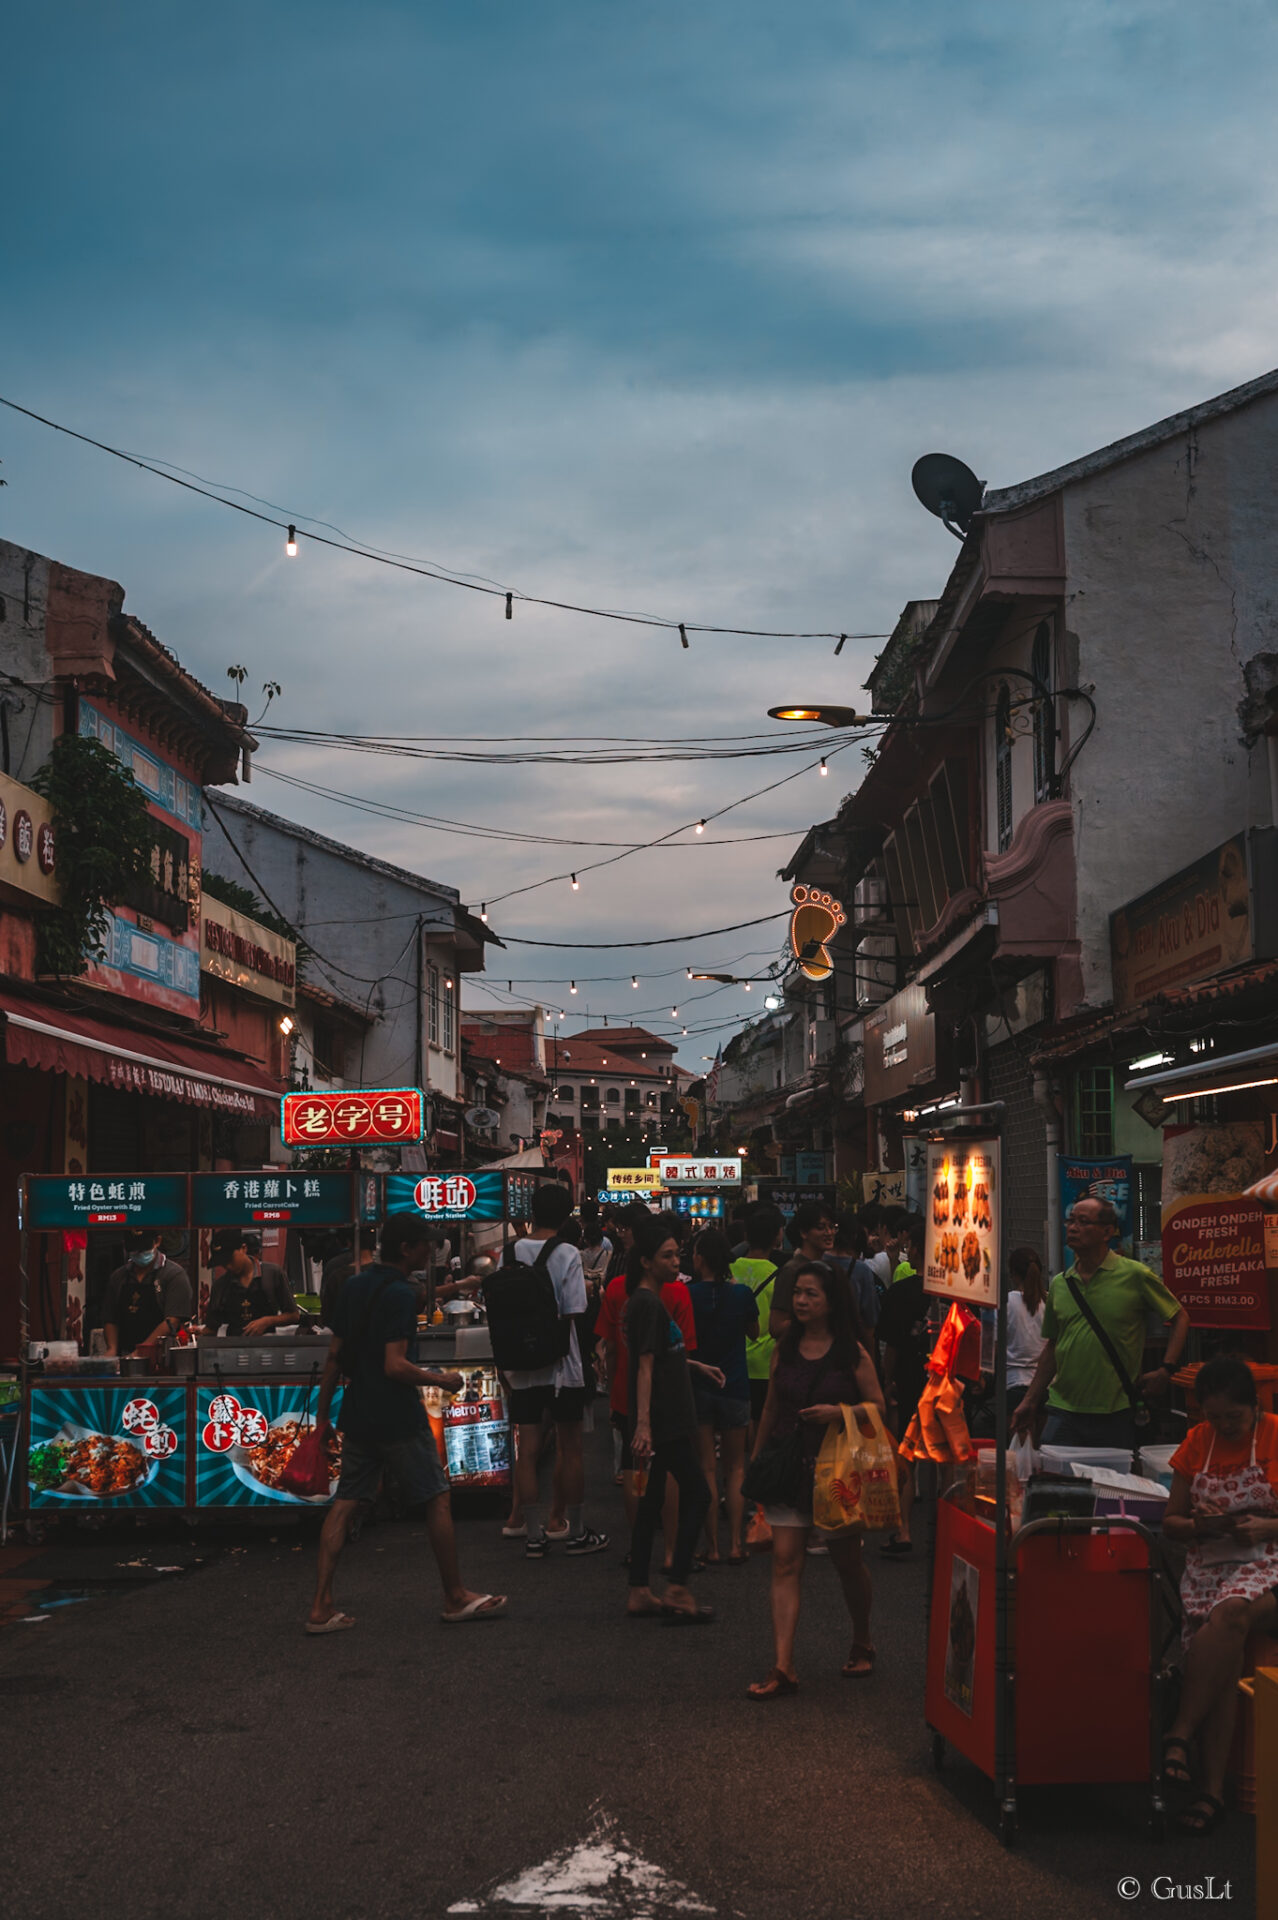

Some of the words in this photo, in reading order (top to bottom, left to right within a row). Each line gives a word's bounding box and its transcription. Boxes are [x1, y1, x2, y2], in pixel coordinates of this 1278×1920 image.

[1158, 912, 1180, 959] Aku
[1183, 899, 1194, 946] &
[1194, 887, 1220, 940] Dia
[297, 1104, 407, 1132] 老字号
[1066, 1166, 1089, 1179] Aku
[1092, 1167, 1102, 1179] &
[1105, 1167, 1127, 1179] Dia
[91, 1204, 112, 1212] Oyster
[129, 1203, 142, 1212] Egg
[423, 1212, 443, 1220] Oyster
[444, 1211, 467, 1219] Station
[1171, 1216, 1217, 1231] ONDEH
[1219, 1211, 1263, 1226] ONDEH
[1198, 1226, 1239, 1240] FRESH
[1172, 1236, 1263, 1266] Cinderella
[1175, 1265, 1211, 1278] BUAH
[1212, 1260, 1265, 1275] MELAKA
[1200, 1274, 1240, 1287] FRESH
[1180, 1295, 1188, 1304] 4
[1189, 1295, 1211, 1304] PCS
[1214, 1296, 1255, 1305] RM3.00
